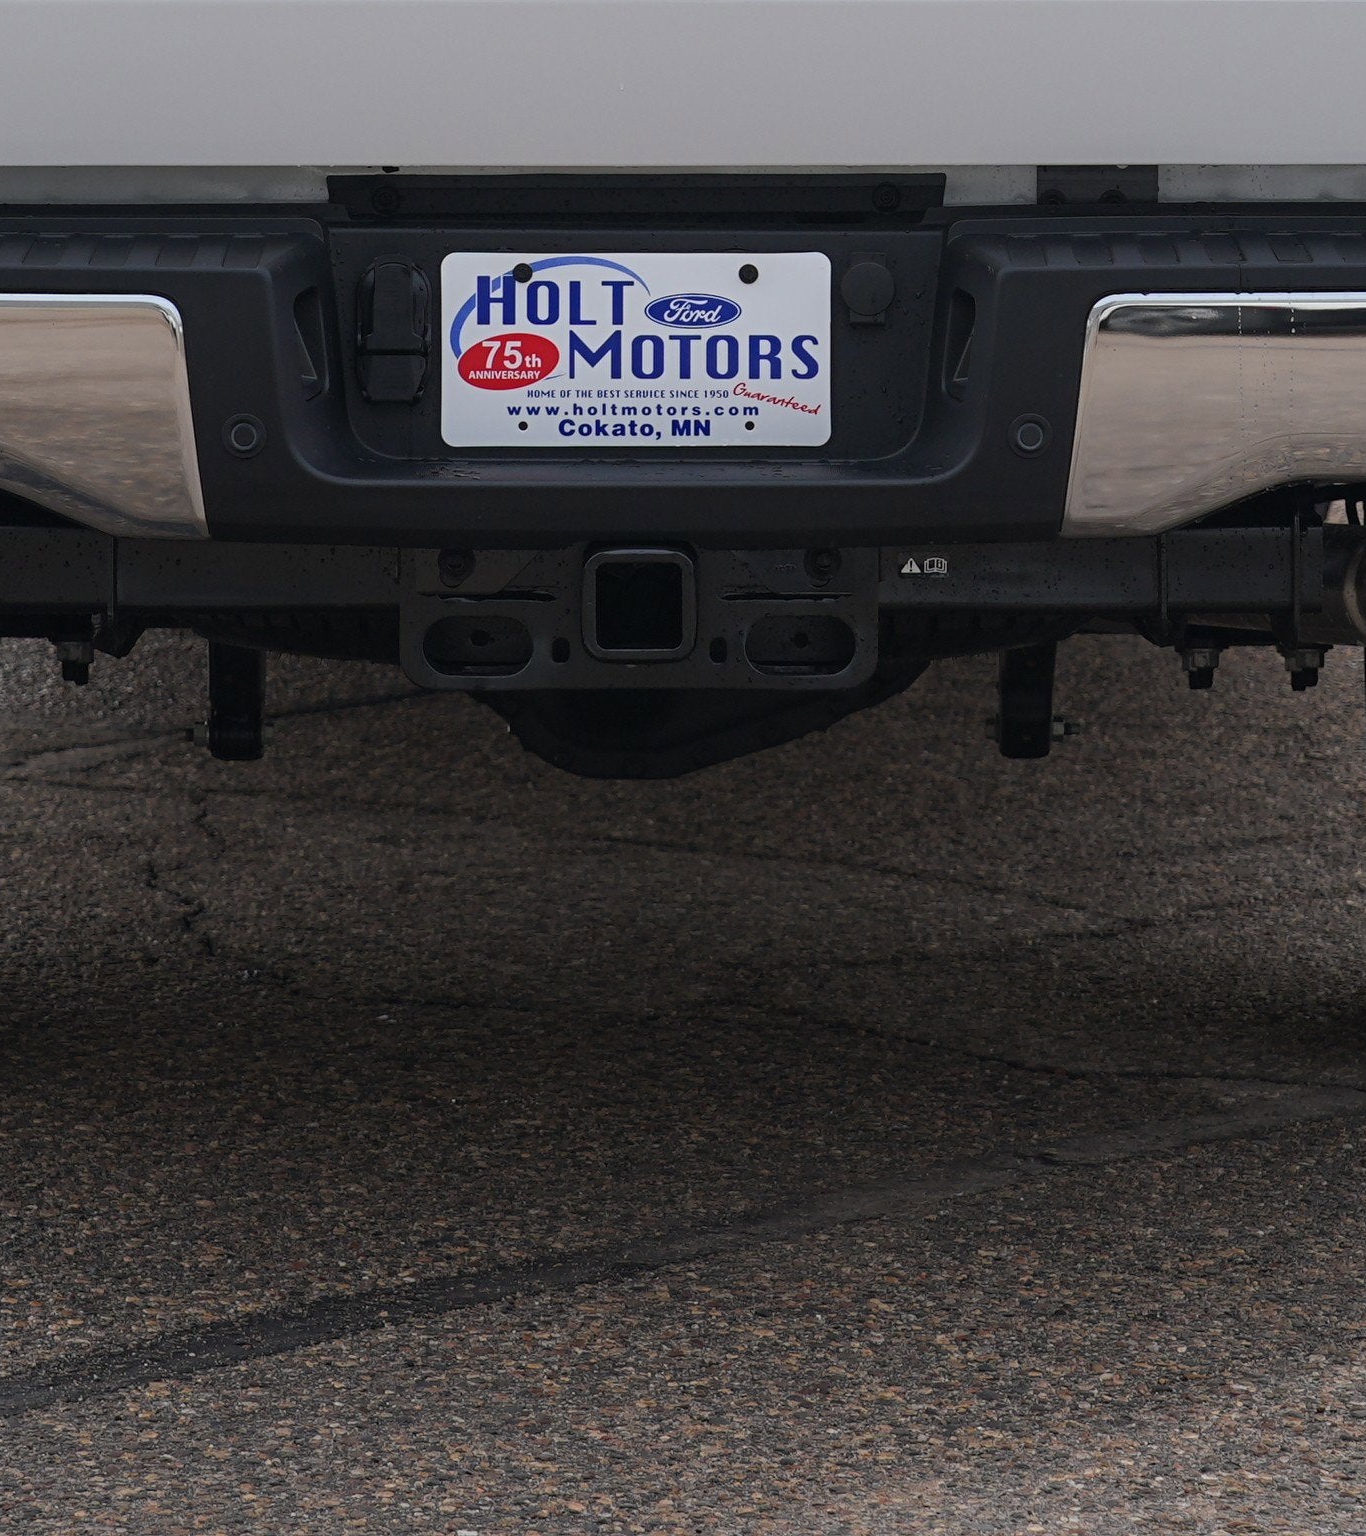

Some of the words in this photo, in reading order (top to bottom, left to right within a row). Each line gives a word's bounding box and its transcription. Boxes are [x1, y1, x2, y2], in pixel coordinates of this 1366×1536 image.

[476, 275, 635, 326] HOLT
[662, 298, 723, 325] Ford
[481, 340, 543, 370] 75th
[568, 329, 820, 381] MOTORS
[468, 369, 541, 381] ANNIVERSARY
[527, 389, 557, 399] HOME
[560, 389, 572, 399] OF
[574, 389, 595, 399] THE
[596, 389, 622, 399] BEST
[624, 389, 667, 399] SERVICE
[669, 389, 701, 399] SINCE
[703, 389, 730, 399] 1950
[732, 382, 821, 416] Guaranteed
[507, 402, 760, 417] www.holtmotors.com
[558, 419, 662, 440] Cokato,
[671, 419, 711, 437] MN
